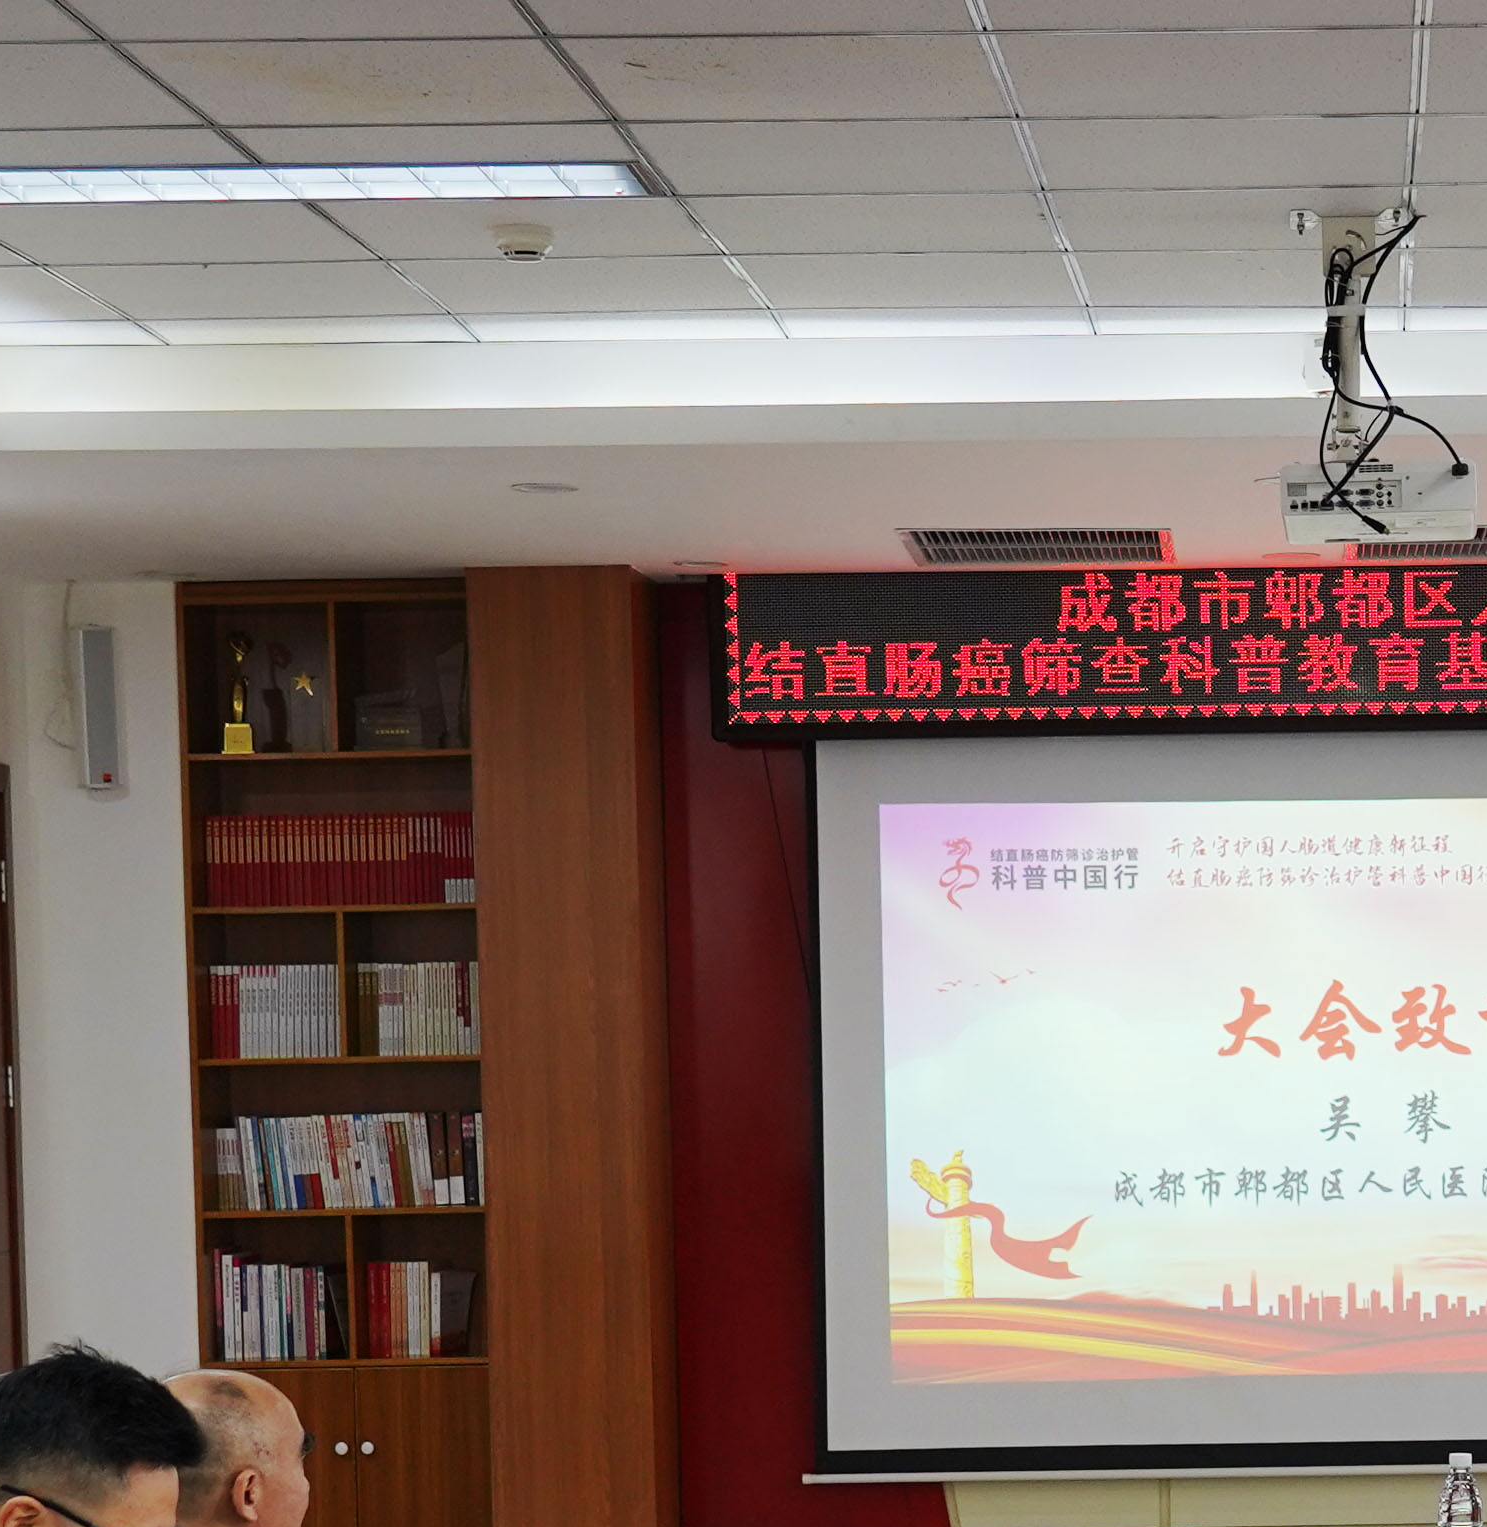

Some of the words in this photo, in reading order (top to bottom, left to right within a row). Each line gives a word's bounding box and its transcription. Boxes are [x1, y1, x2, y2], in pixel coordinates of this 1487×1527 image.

[990, 847, 1139, 862] 结直肠癌防筛诊治护管
[990, 864, 1139, 891] 科普中国行
